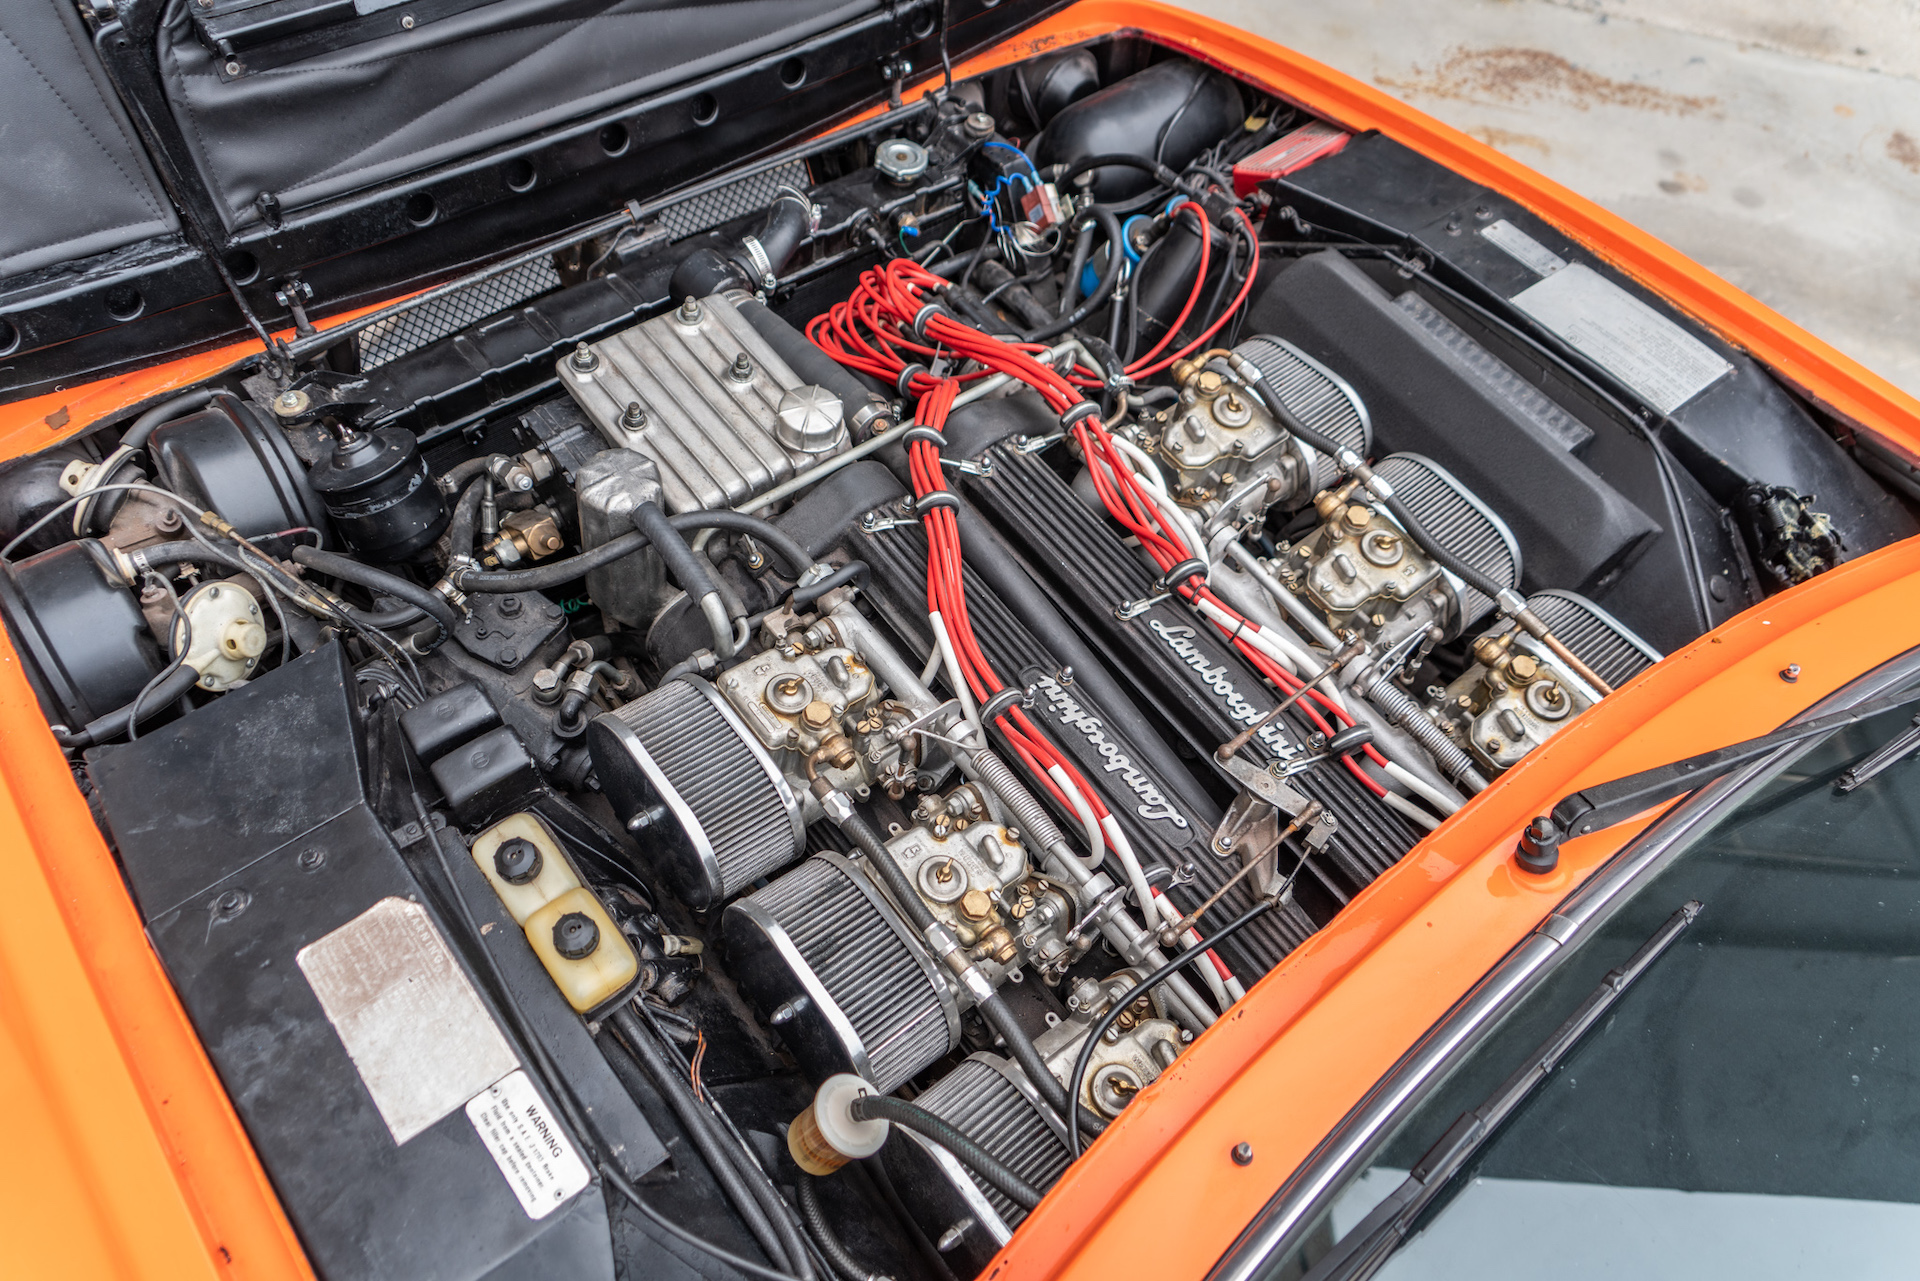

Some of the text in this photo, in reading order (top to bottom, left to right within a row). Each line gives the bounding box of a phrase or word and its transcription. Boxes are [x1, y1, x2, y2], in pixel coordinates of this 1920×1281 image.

[1030, 675, 1188, 828] Lamborghini
[404, 904, 444, 964] WARNING
[501, 1098, 510, 1110] Use
[526, 1104, 562, 1158] WARNING
[491, 1105, 503, 1120] Fluid
[501, 1121, 510, 1134] from
[513, 1142, 528, 1160] sealed
[499, 1144, 508, 1155] cap
[507, 1155, 519, 1174] before
